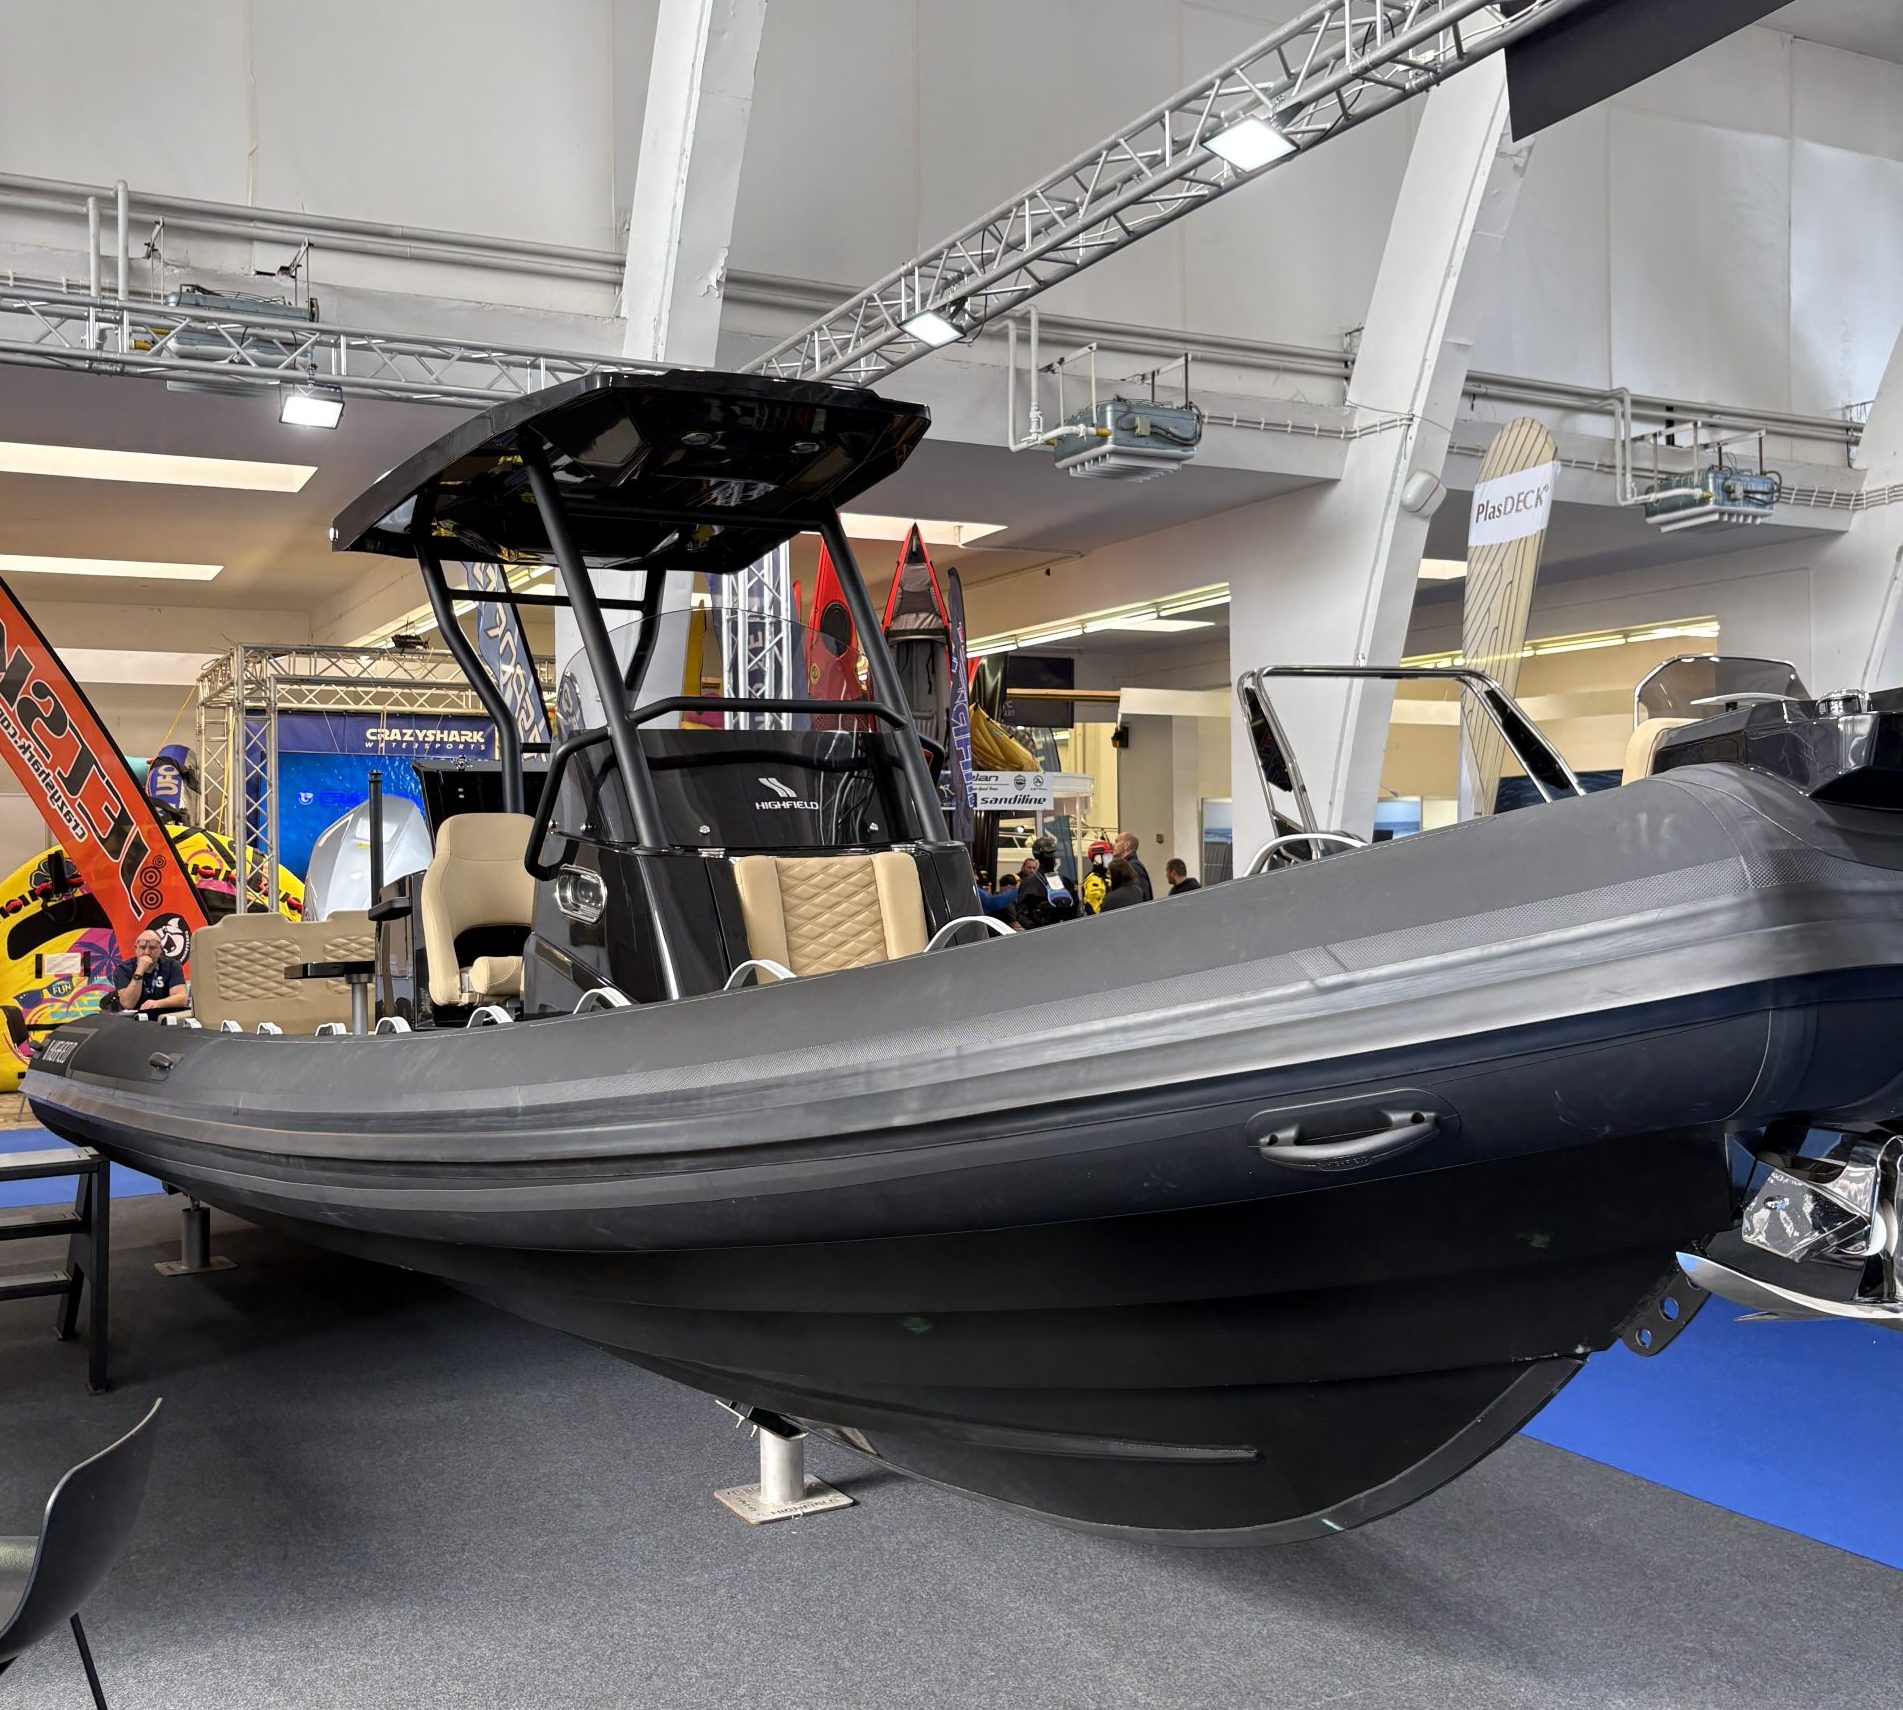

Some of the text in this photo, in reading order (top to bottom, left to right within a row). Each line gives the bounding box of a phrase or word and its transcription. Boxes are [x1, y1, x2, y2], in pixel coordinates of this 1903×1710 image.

[365, 728, 485, 743] CRAZYSHARK
[980, 794, 1047, 805] sandiline
[755, 801, 819, 810] HIGHFIELD
[52, 983, 72, 995] FUN
